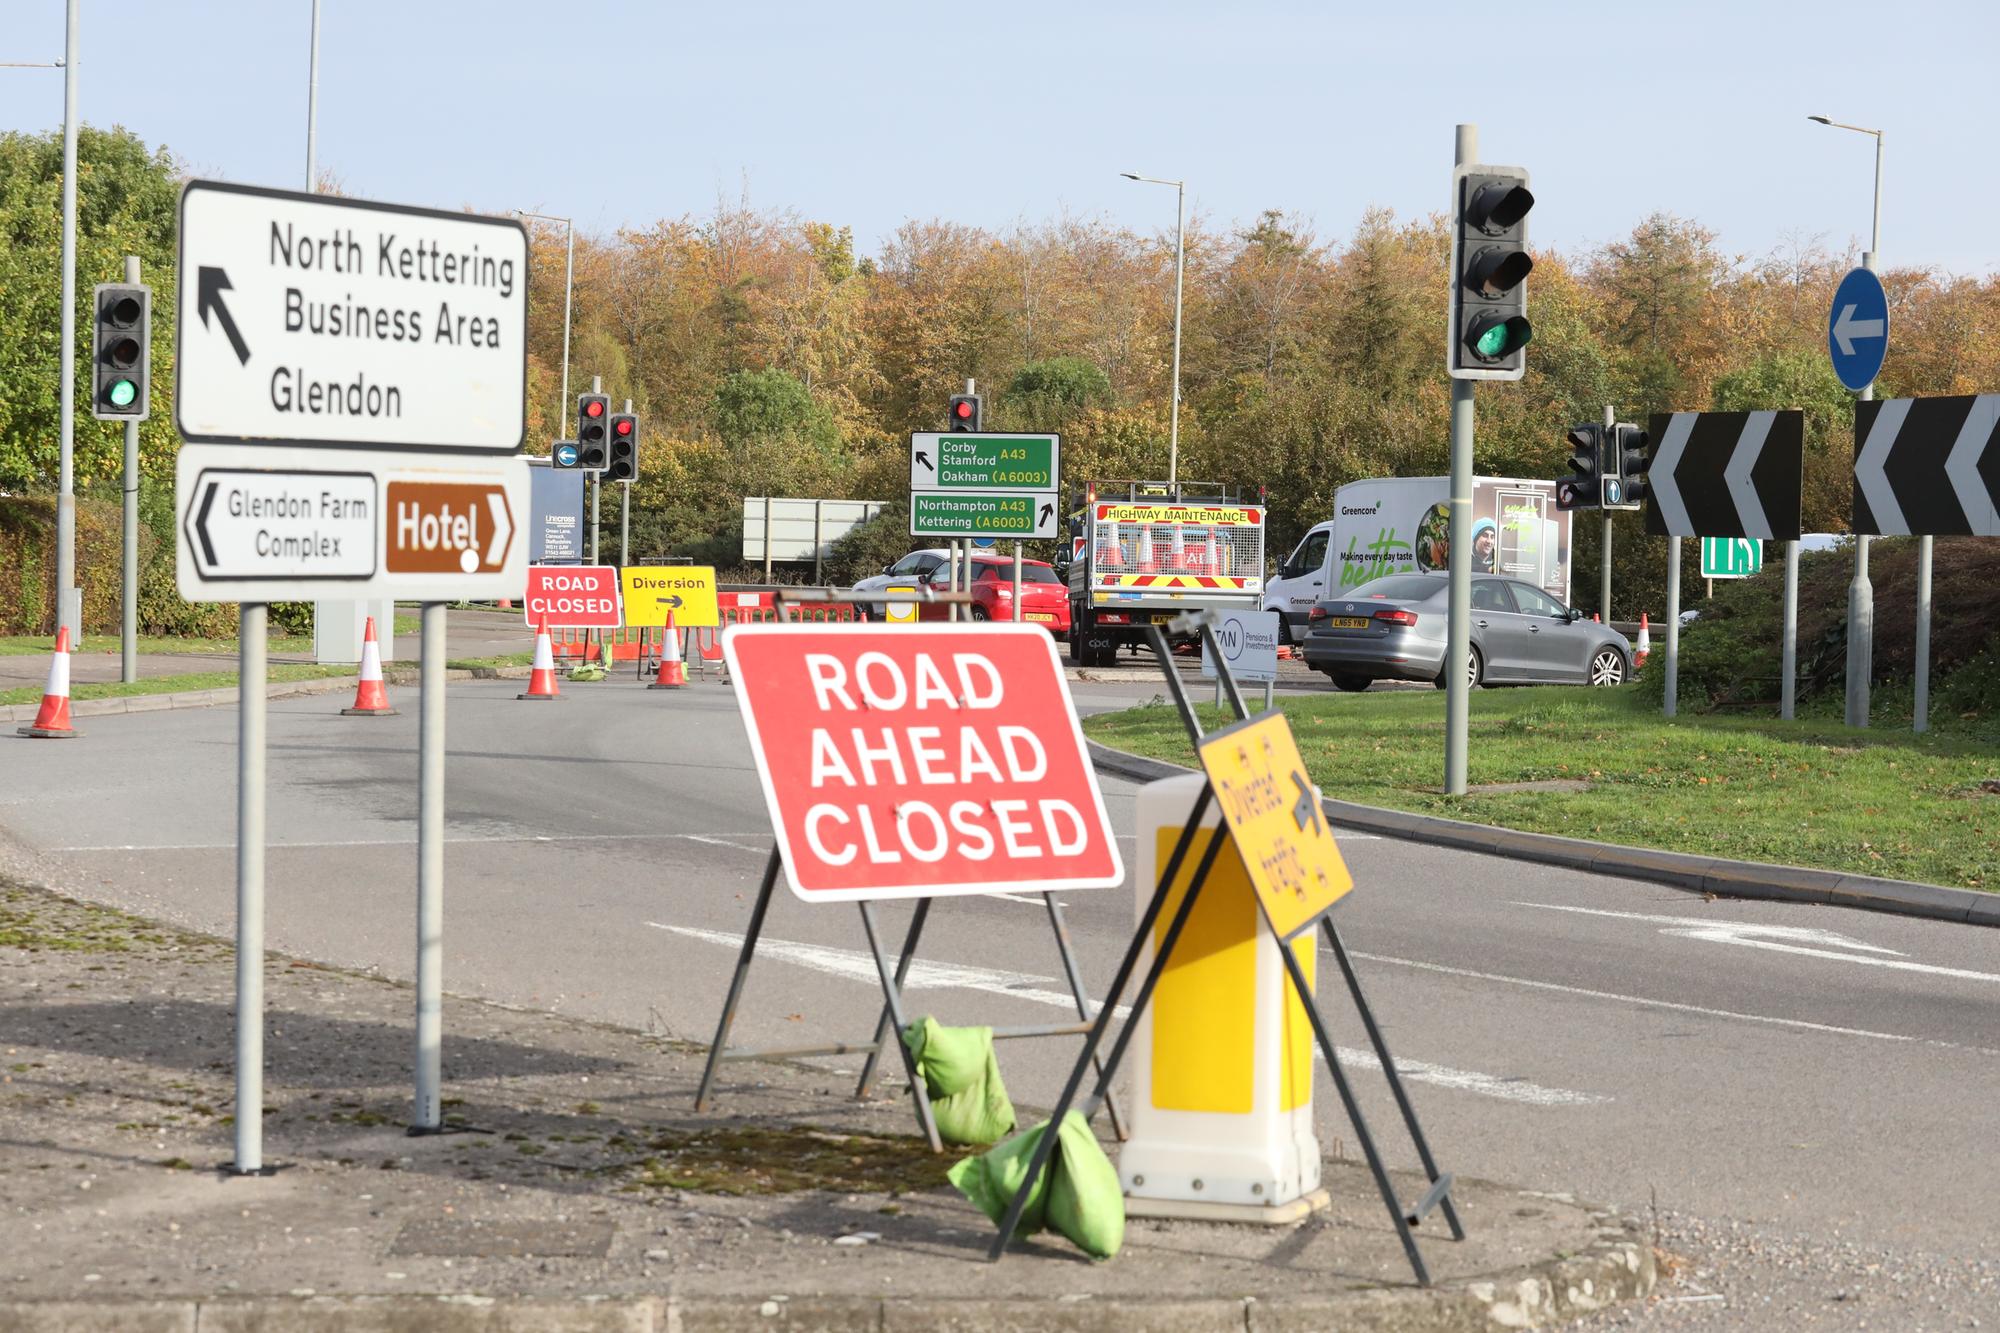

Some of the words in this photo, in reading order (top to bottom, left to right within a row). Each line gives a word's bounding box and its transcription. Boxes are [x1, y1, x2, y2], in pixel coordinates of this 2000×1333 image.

[270, 220, 362, 275] North
[379, 233, 513, 299] Kettering
[286, 287, 421, 342] Business
[435, 302, 500, 349] Area
[270, 366, 401, 418] Glendon
[942, 441, 977, 454] Corby
[1001, 449, 1026, 460] A43
[942, 455, 996, 465] Stamford
[942, 471, 988, 482] Oakham
[992, 471, 1048, 484] (A6003)
[228, 489, 311, 520] Glendon
[320, 492, 367, 520] Farm
[919, 500, 996, 512] Northampton
[1000, 501, 1026, 512] A43
[1341, 506, 1377, 516] Greencore
[919, 516, 972, 528] Kettering
[975, 516, 1031, 529] (A6003)
[1108, 509, 1160, 520] HIGHWAY
[1164, 510, 1247, 522] MAINTENANCE
[397, 501, 479, 551] Hotel
[256, 529, 341, 562] Complex
[1340, 552, 1364, 563] Making
[1364, 553, 1384, 563] every
[1384, 552, 1396, 562] day
[1396, 552, 1413, 561] taste
[542, 576, 599, 591] ROAD
[633, 577, 705, 589] Diversion
[531, 598, 614, 614] CLOSED
[1290, 597, 1316, 605] Greencore
[1245, 632, 1266, 642] Pensions
[1269, 634, 1273, 642] &
[1245, 641, 1276, 650] Investments
[804, 651, 1004, 711] ROAD
[811, 726, 1047, 787] AHEAD
[1221, 762, 1283, 825] Diverted
[804, 799, 1088, 866] CLOSED
[1257, 837, 1306, 894] traffic
